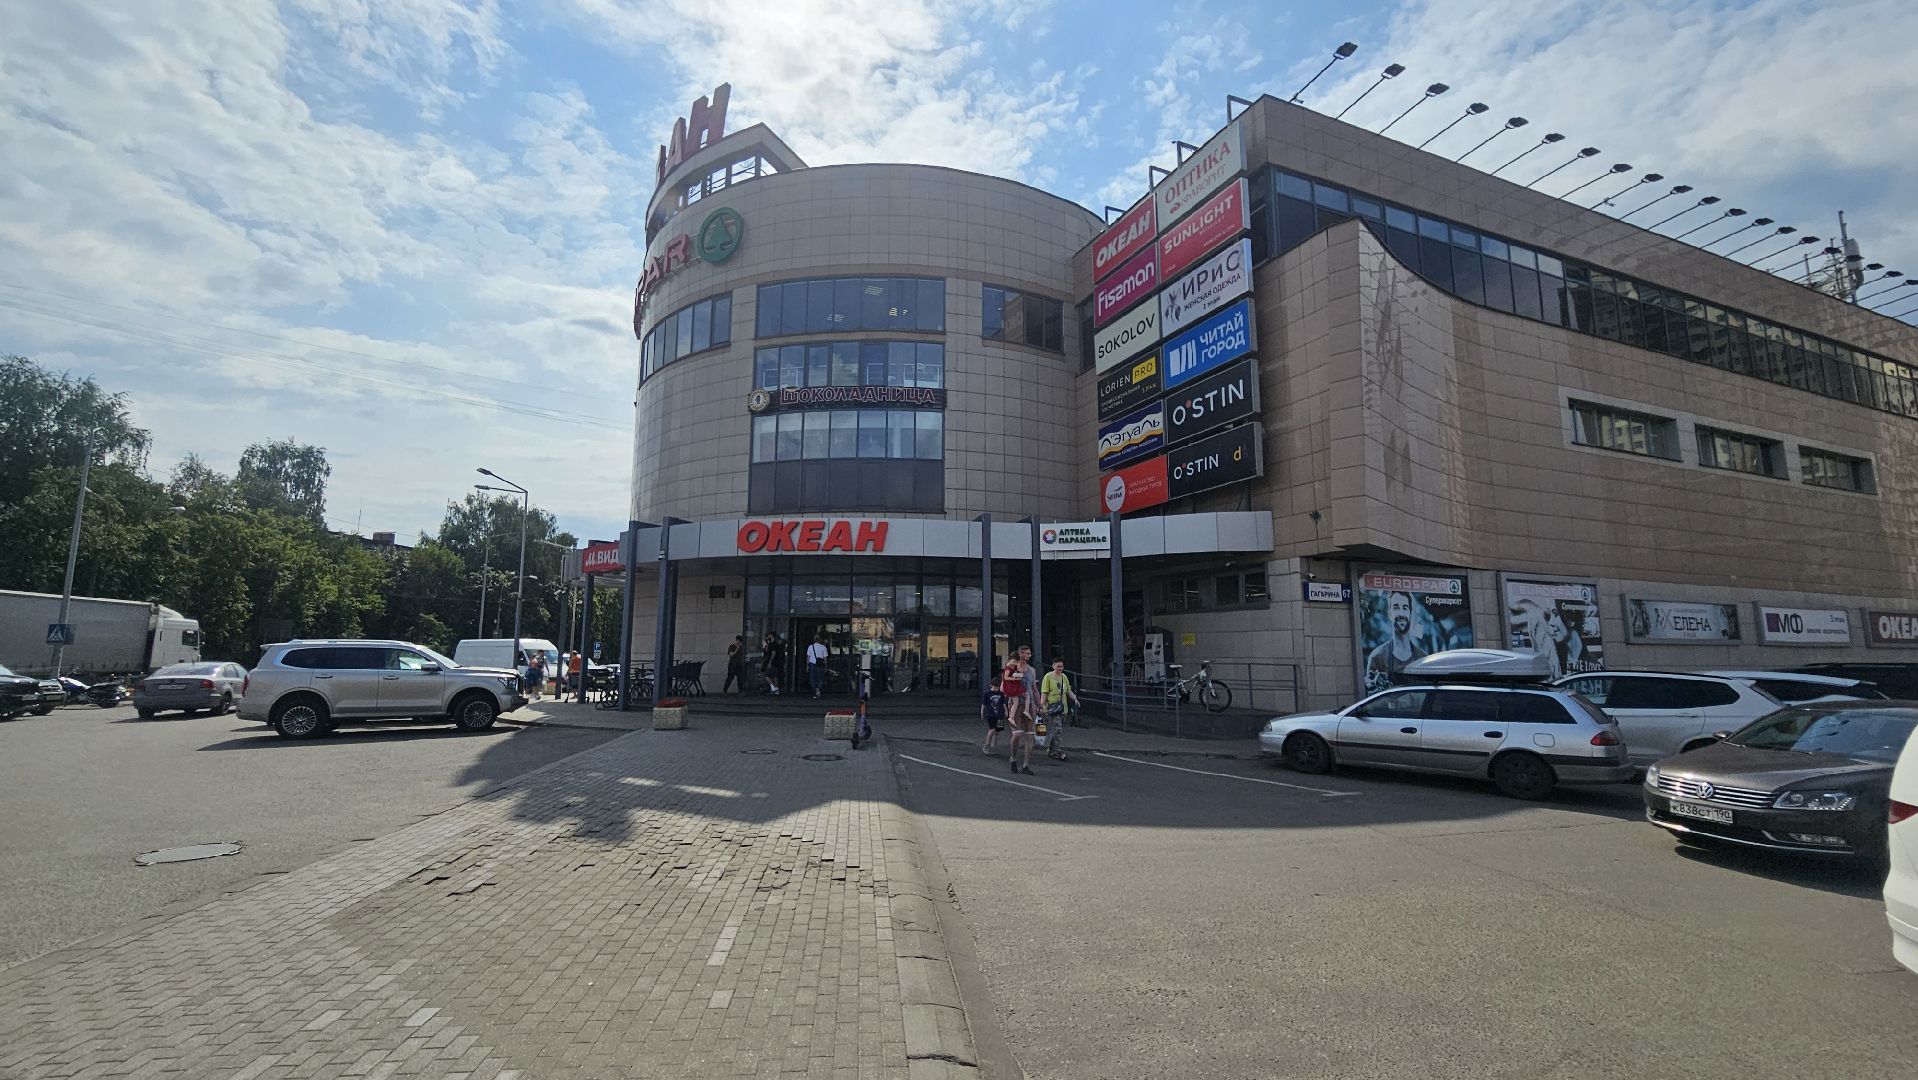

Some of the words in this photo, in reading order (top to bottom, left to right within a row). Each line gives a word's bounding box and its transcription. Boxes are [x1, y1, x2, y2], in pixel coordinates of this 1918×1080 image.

[1165, 141, 1231, 204] ОПТИКА
[1096, 210, 1151, 268] ОКЕАН
[1164, 194, 1234, 255] SUNLIGHT
[1212, 273, 1242, 294] ОДЕЖДА
[1098, 313, 1155, 359] SOKOLOV
[1200, 311, 1244, 346] ЧИТАЙ
[1201, 330, 1246, 364] ГОРОД
[1135, 363, 1153, 379] PRO
[780, 386, 936, 405] ШОКОЛАДНИЦА
[1173, 379, 1244, 426] O'STIN
[1173, 453, 1219, 480] O'STIN
[737, 520, 889, 553] ОКЕАН
[1059, 528, 1091, 536] АПТЕКА
[1310, 590, 1341, 598] ГАГАРИНА
[1342, 589, 1351, 599] 67
[1373, 577, 1448, 591] EUROSPAR
[1425, 595, 1463, 607] Супермаркет
